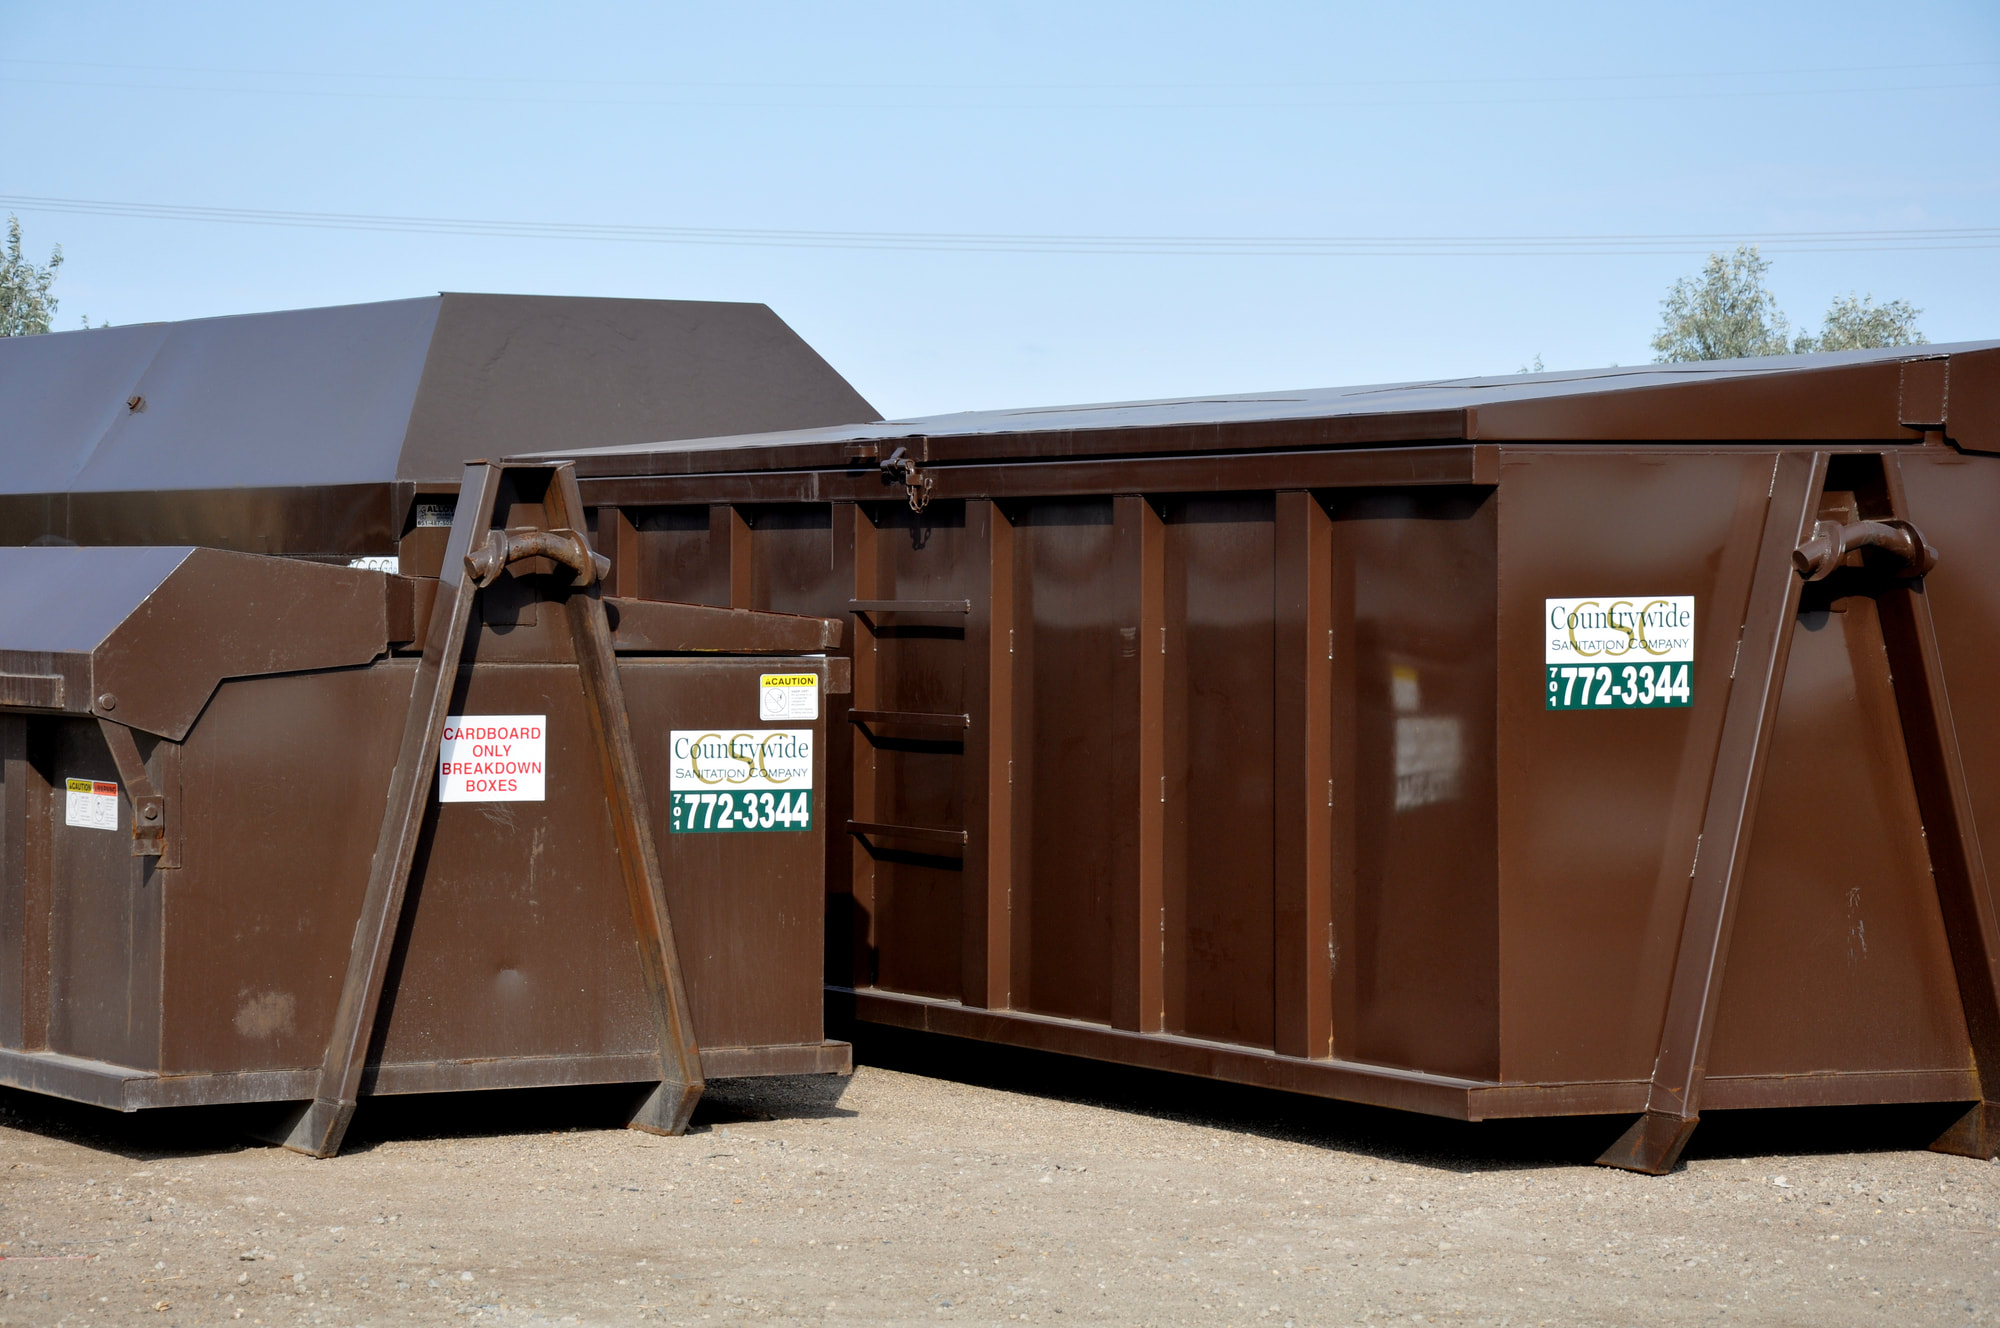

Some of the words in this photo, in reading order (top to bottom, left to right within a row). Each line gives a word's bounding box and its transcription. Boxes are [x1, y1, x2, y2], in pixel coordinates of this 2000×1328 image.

[1551, 603, 1690, 635] Countrywide
[1568, 600, 1671, 657] CSC
[1552, 639, 1624, 651] SANITATION
[1628, 638, 1689, 650] COMPANY
[771, 677, 814, 686] CAUTION
[1560, 664, 1690, 706] 772-3344
[443, 727, 541, 740] CARDBOARD
[472, 744, 512, 757] ONLY
[675, 735, 809, 765] Countrywide
[691, 733, 790, 784] CSC
[442, 761, 542, 775] BREAKDOWN
[675, 768, 745, 779] SANITATION
[749, 767, 808, 778] COMPANY
[465, 779, 518, 792] BOXES
[684, 791, 809, 829] 772-3344
